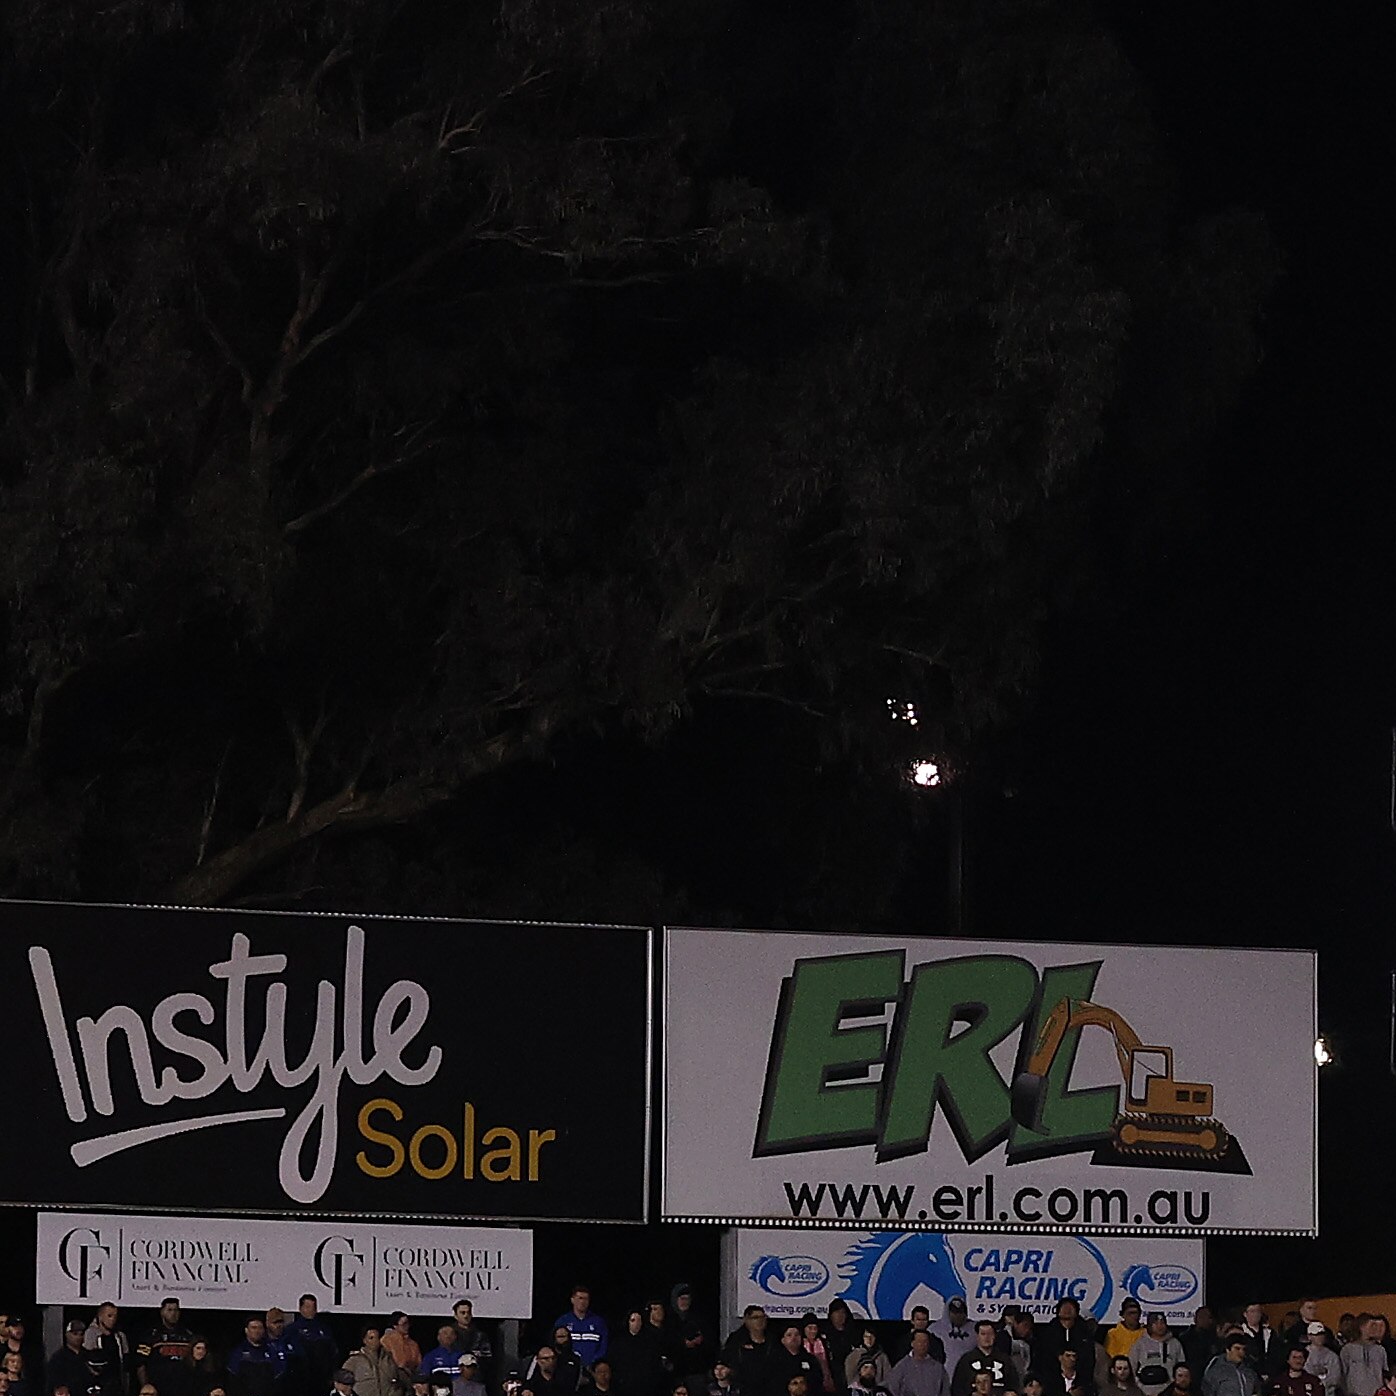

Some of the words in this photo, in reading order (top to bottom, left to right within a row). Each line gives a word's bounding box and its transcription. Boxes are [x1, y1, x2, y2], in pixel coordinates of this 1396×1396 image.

[28, 926, 442, 1204] Instyle
[752, 948, 1121, 1166] ERL
[355, 1098, 556, 1182] Solar
[783, 1175, 1211, 1226] www.erl.com.au
[130, 1240, 259, 1262] CORDWELL
[383, 1247, 510, 1270] CORDWELL
[964, 1248, 1054, 1273] CAPRI
[132, 1261, 249, 1283] FINANCIAL
[385, 1269, 499, 1291] FINANCIAL
[975, 1276, 1089, 1302] RACING
[976, 1303, 986, 1314] &
